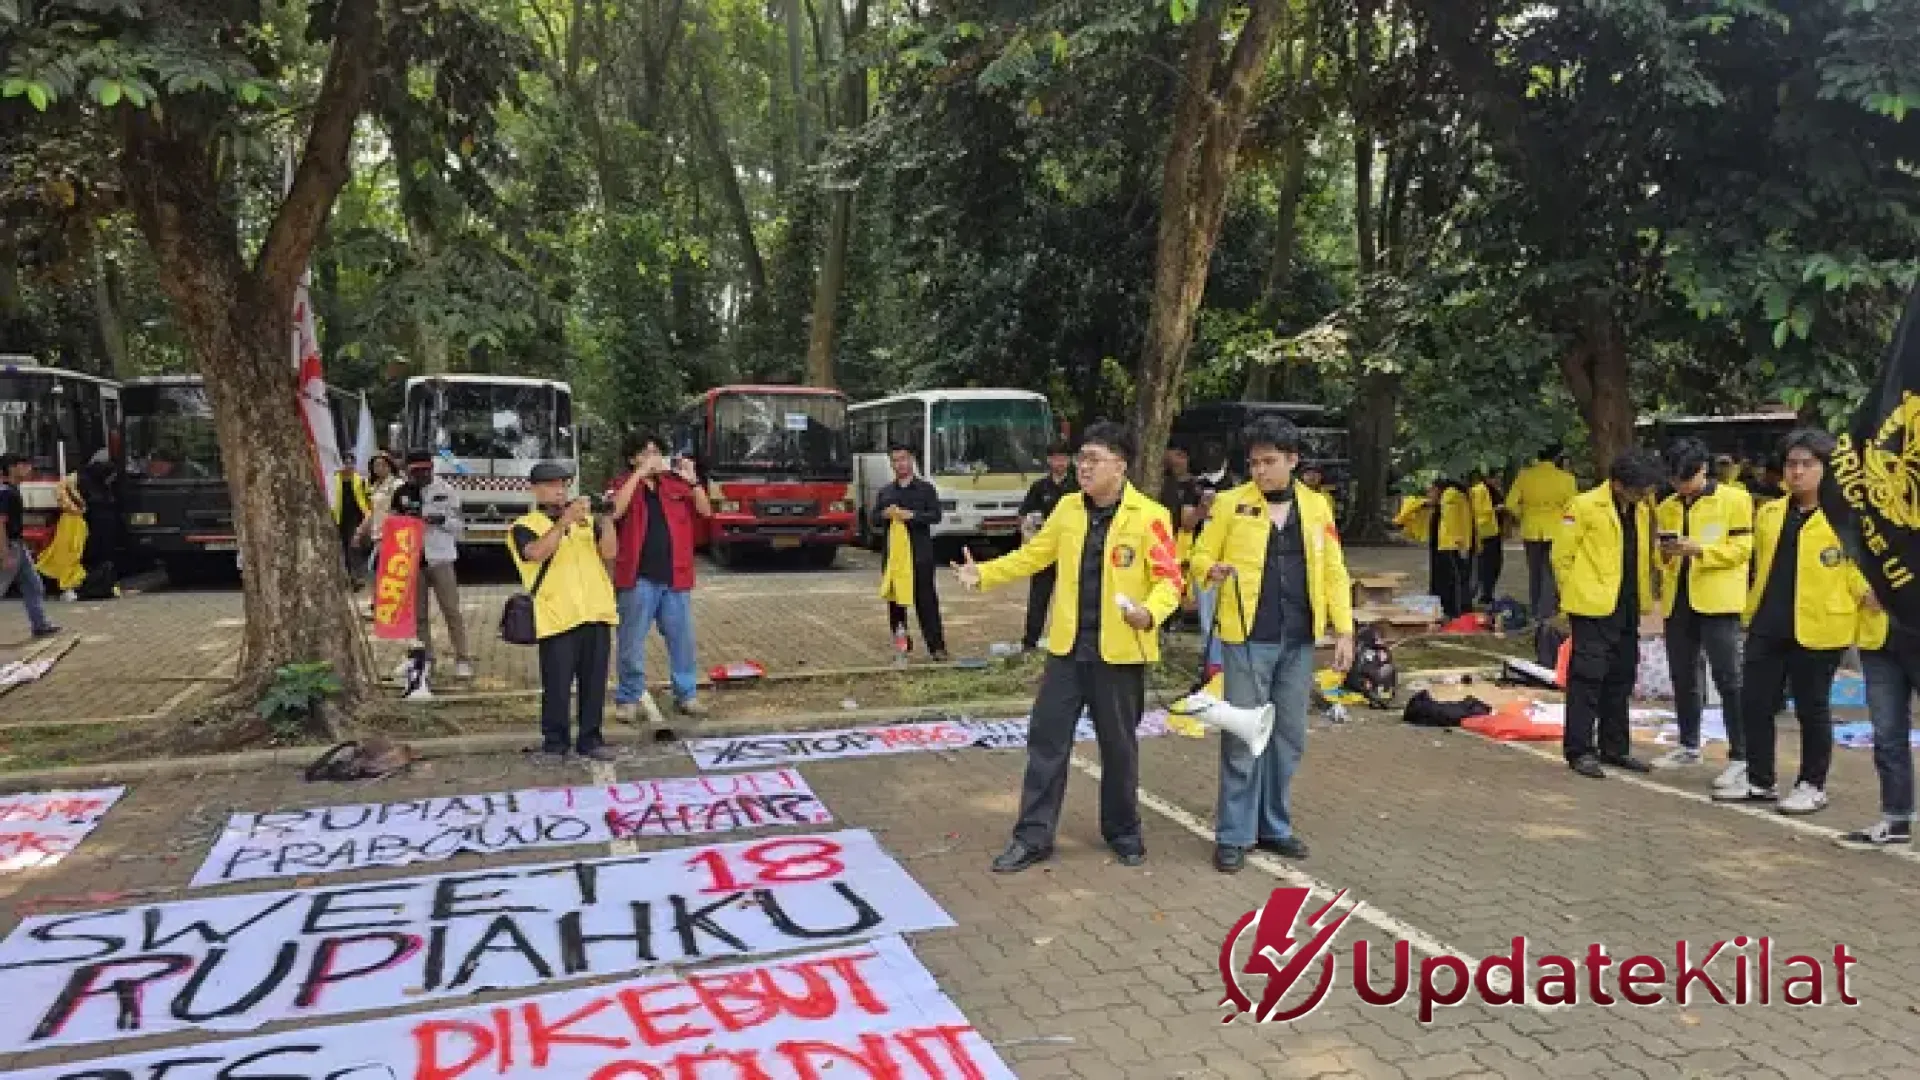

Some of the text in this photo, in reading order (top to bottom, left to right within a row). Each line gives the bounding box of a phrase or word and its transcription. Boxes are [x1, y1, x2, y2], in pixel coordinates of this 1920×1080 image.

[0, 837, 825, 970] SWEET 18
[29, 881, 884, 1041] RUPIAHKU
[411, 951, 889, 1080] DIKEBUT
